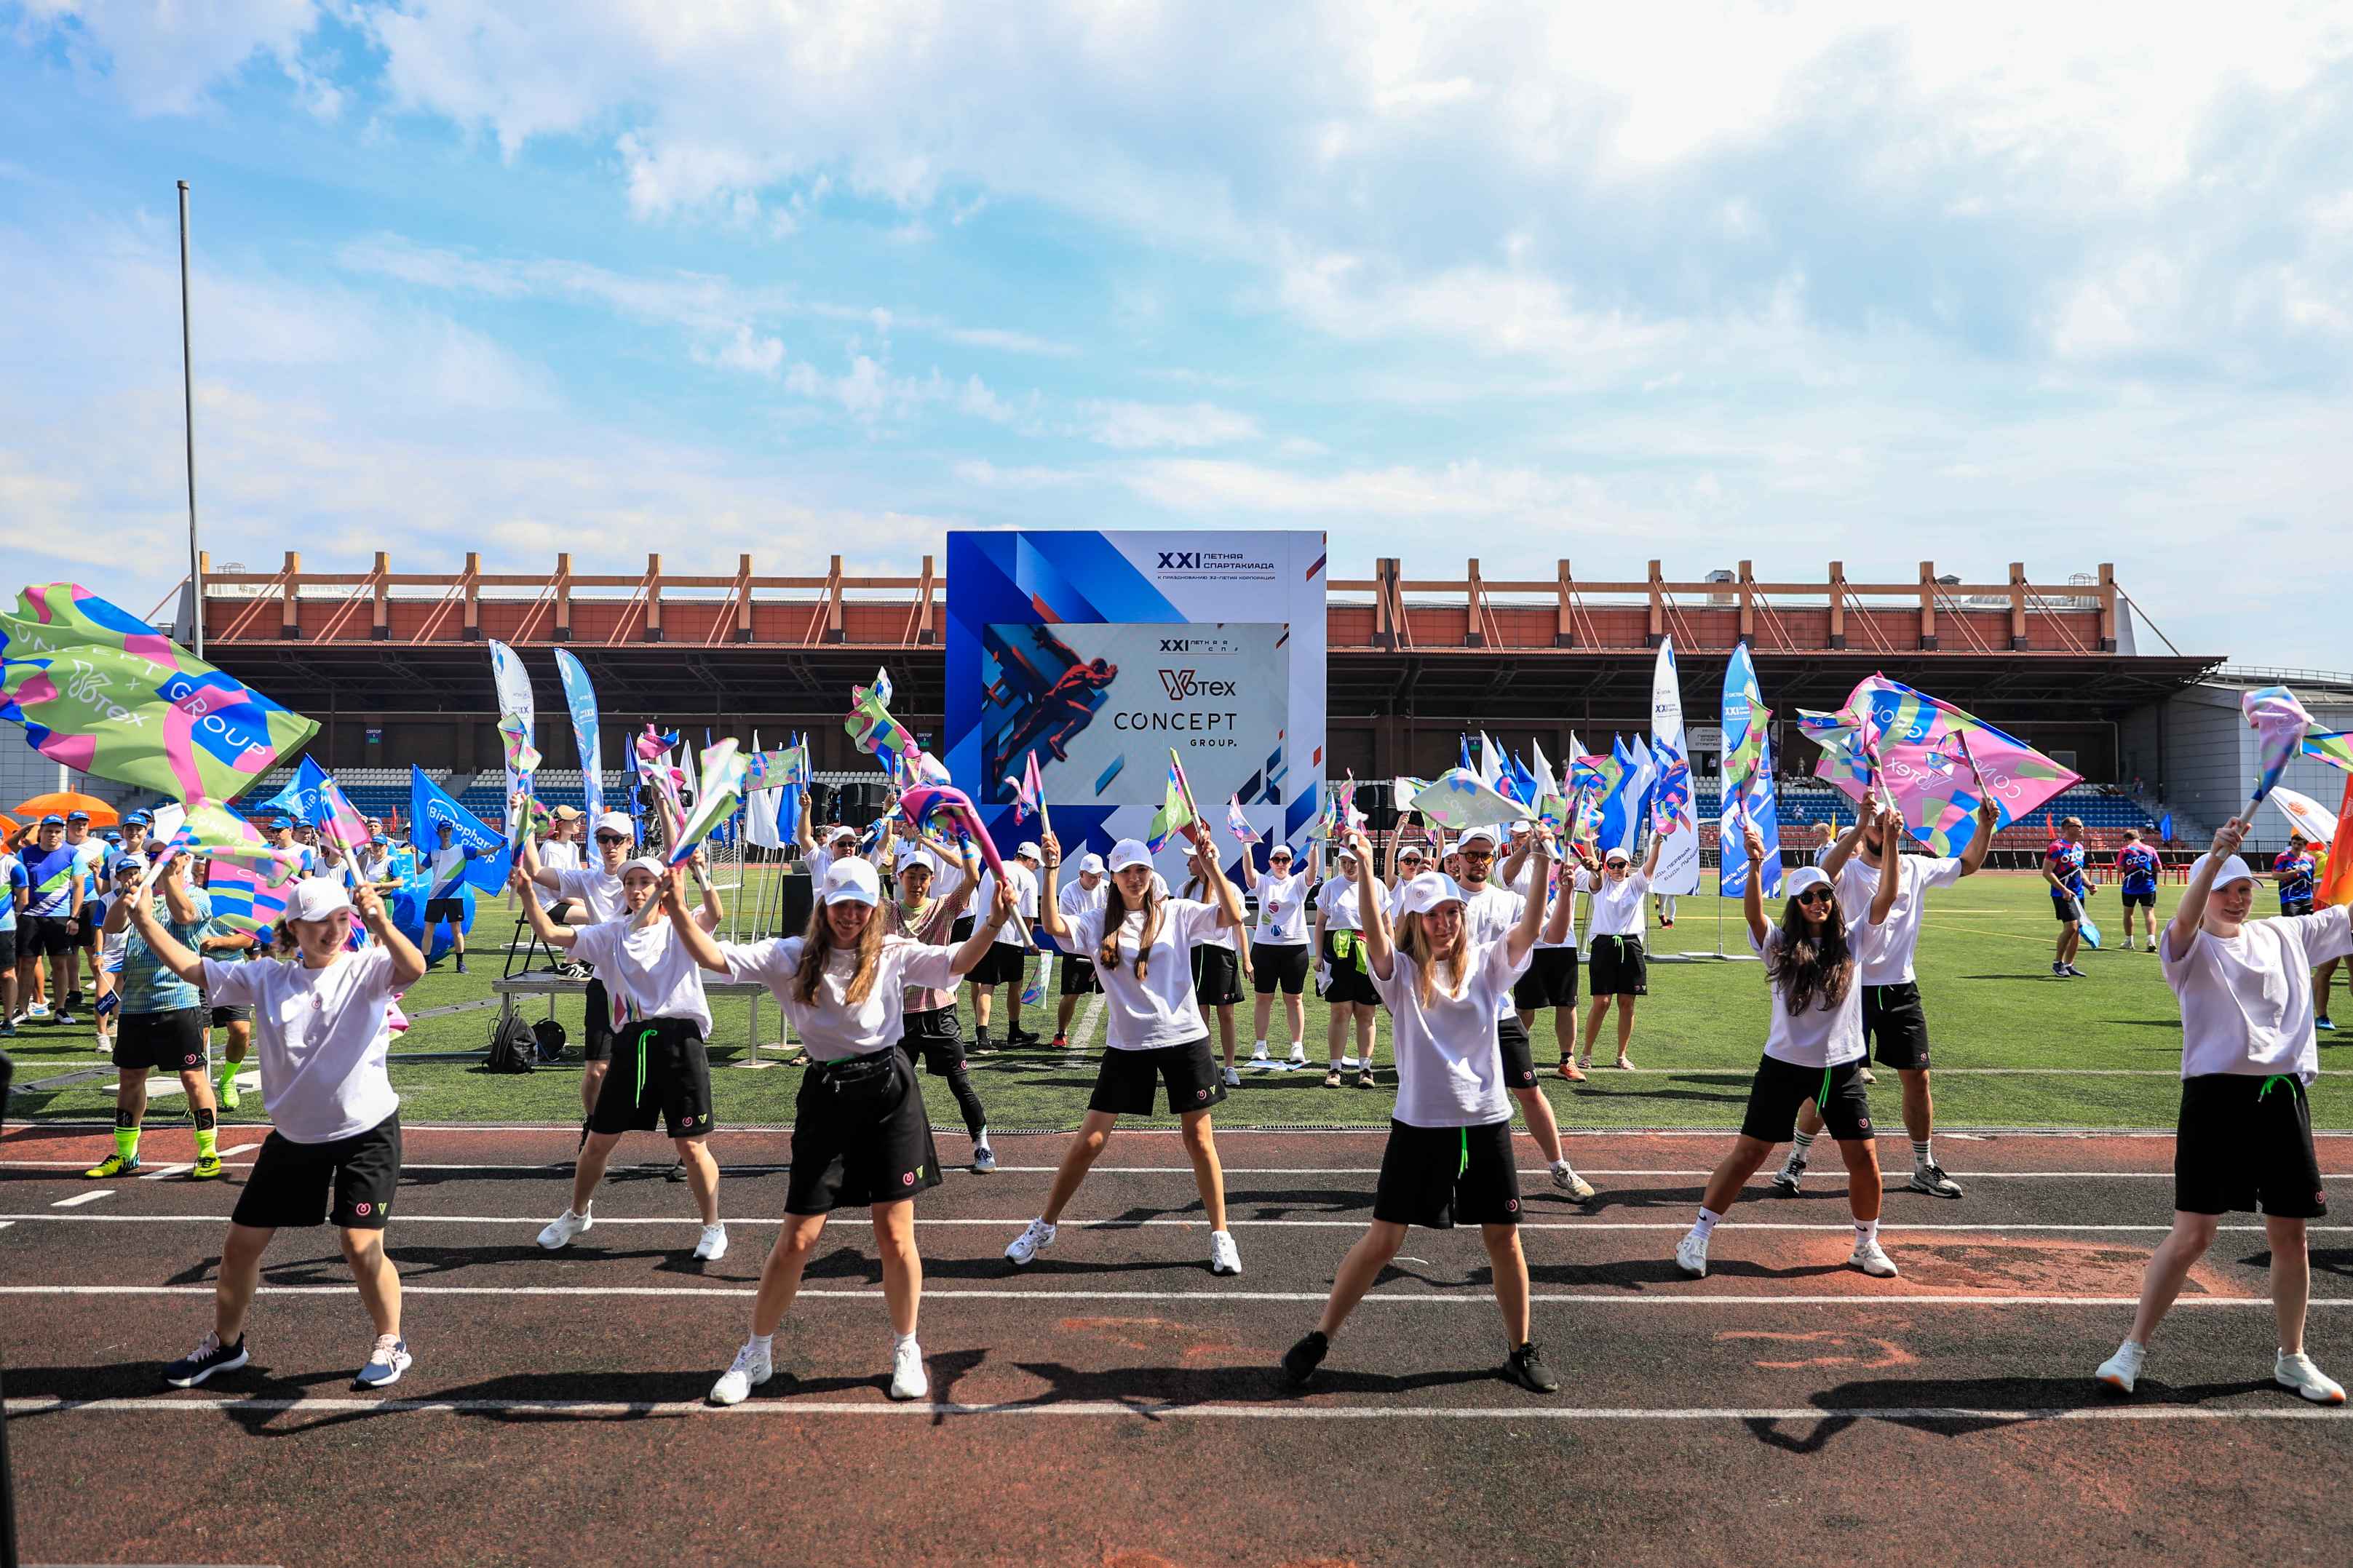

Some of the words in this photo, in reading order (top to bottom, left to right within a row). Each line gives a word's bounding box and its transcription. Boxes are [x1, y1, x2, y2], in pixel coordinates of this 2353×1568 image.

[1157, 552, 1201, 569] XXI
[1159, 640, 1189, 652] XXI
[170, 681, 266, 756] GROUP
[1114, 712, 1237, 731] CONCEPT
